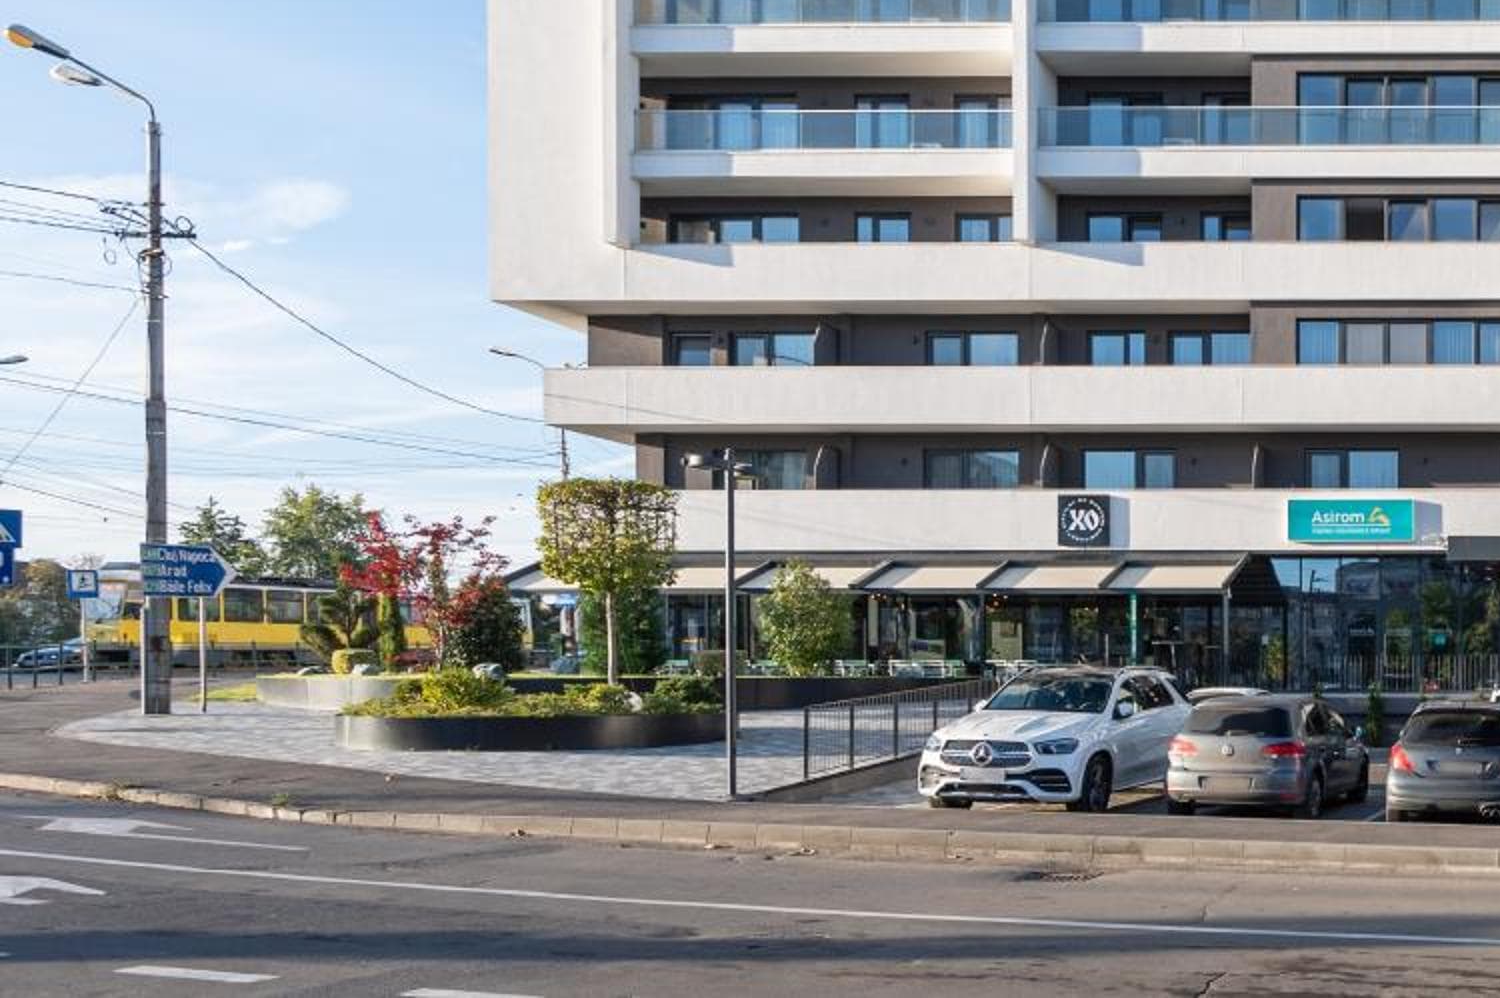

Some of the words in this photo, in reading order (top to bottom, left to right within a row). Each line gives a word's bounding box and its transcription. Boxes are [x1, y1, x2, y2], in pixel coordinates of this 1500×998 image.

[1068, 509, 1099, 531] XO
[1311, 509, 1365, 523] Asirom
[160, 564, 187, 577] Arad
[187, 579, 214, 593] Felix
